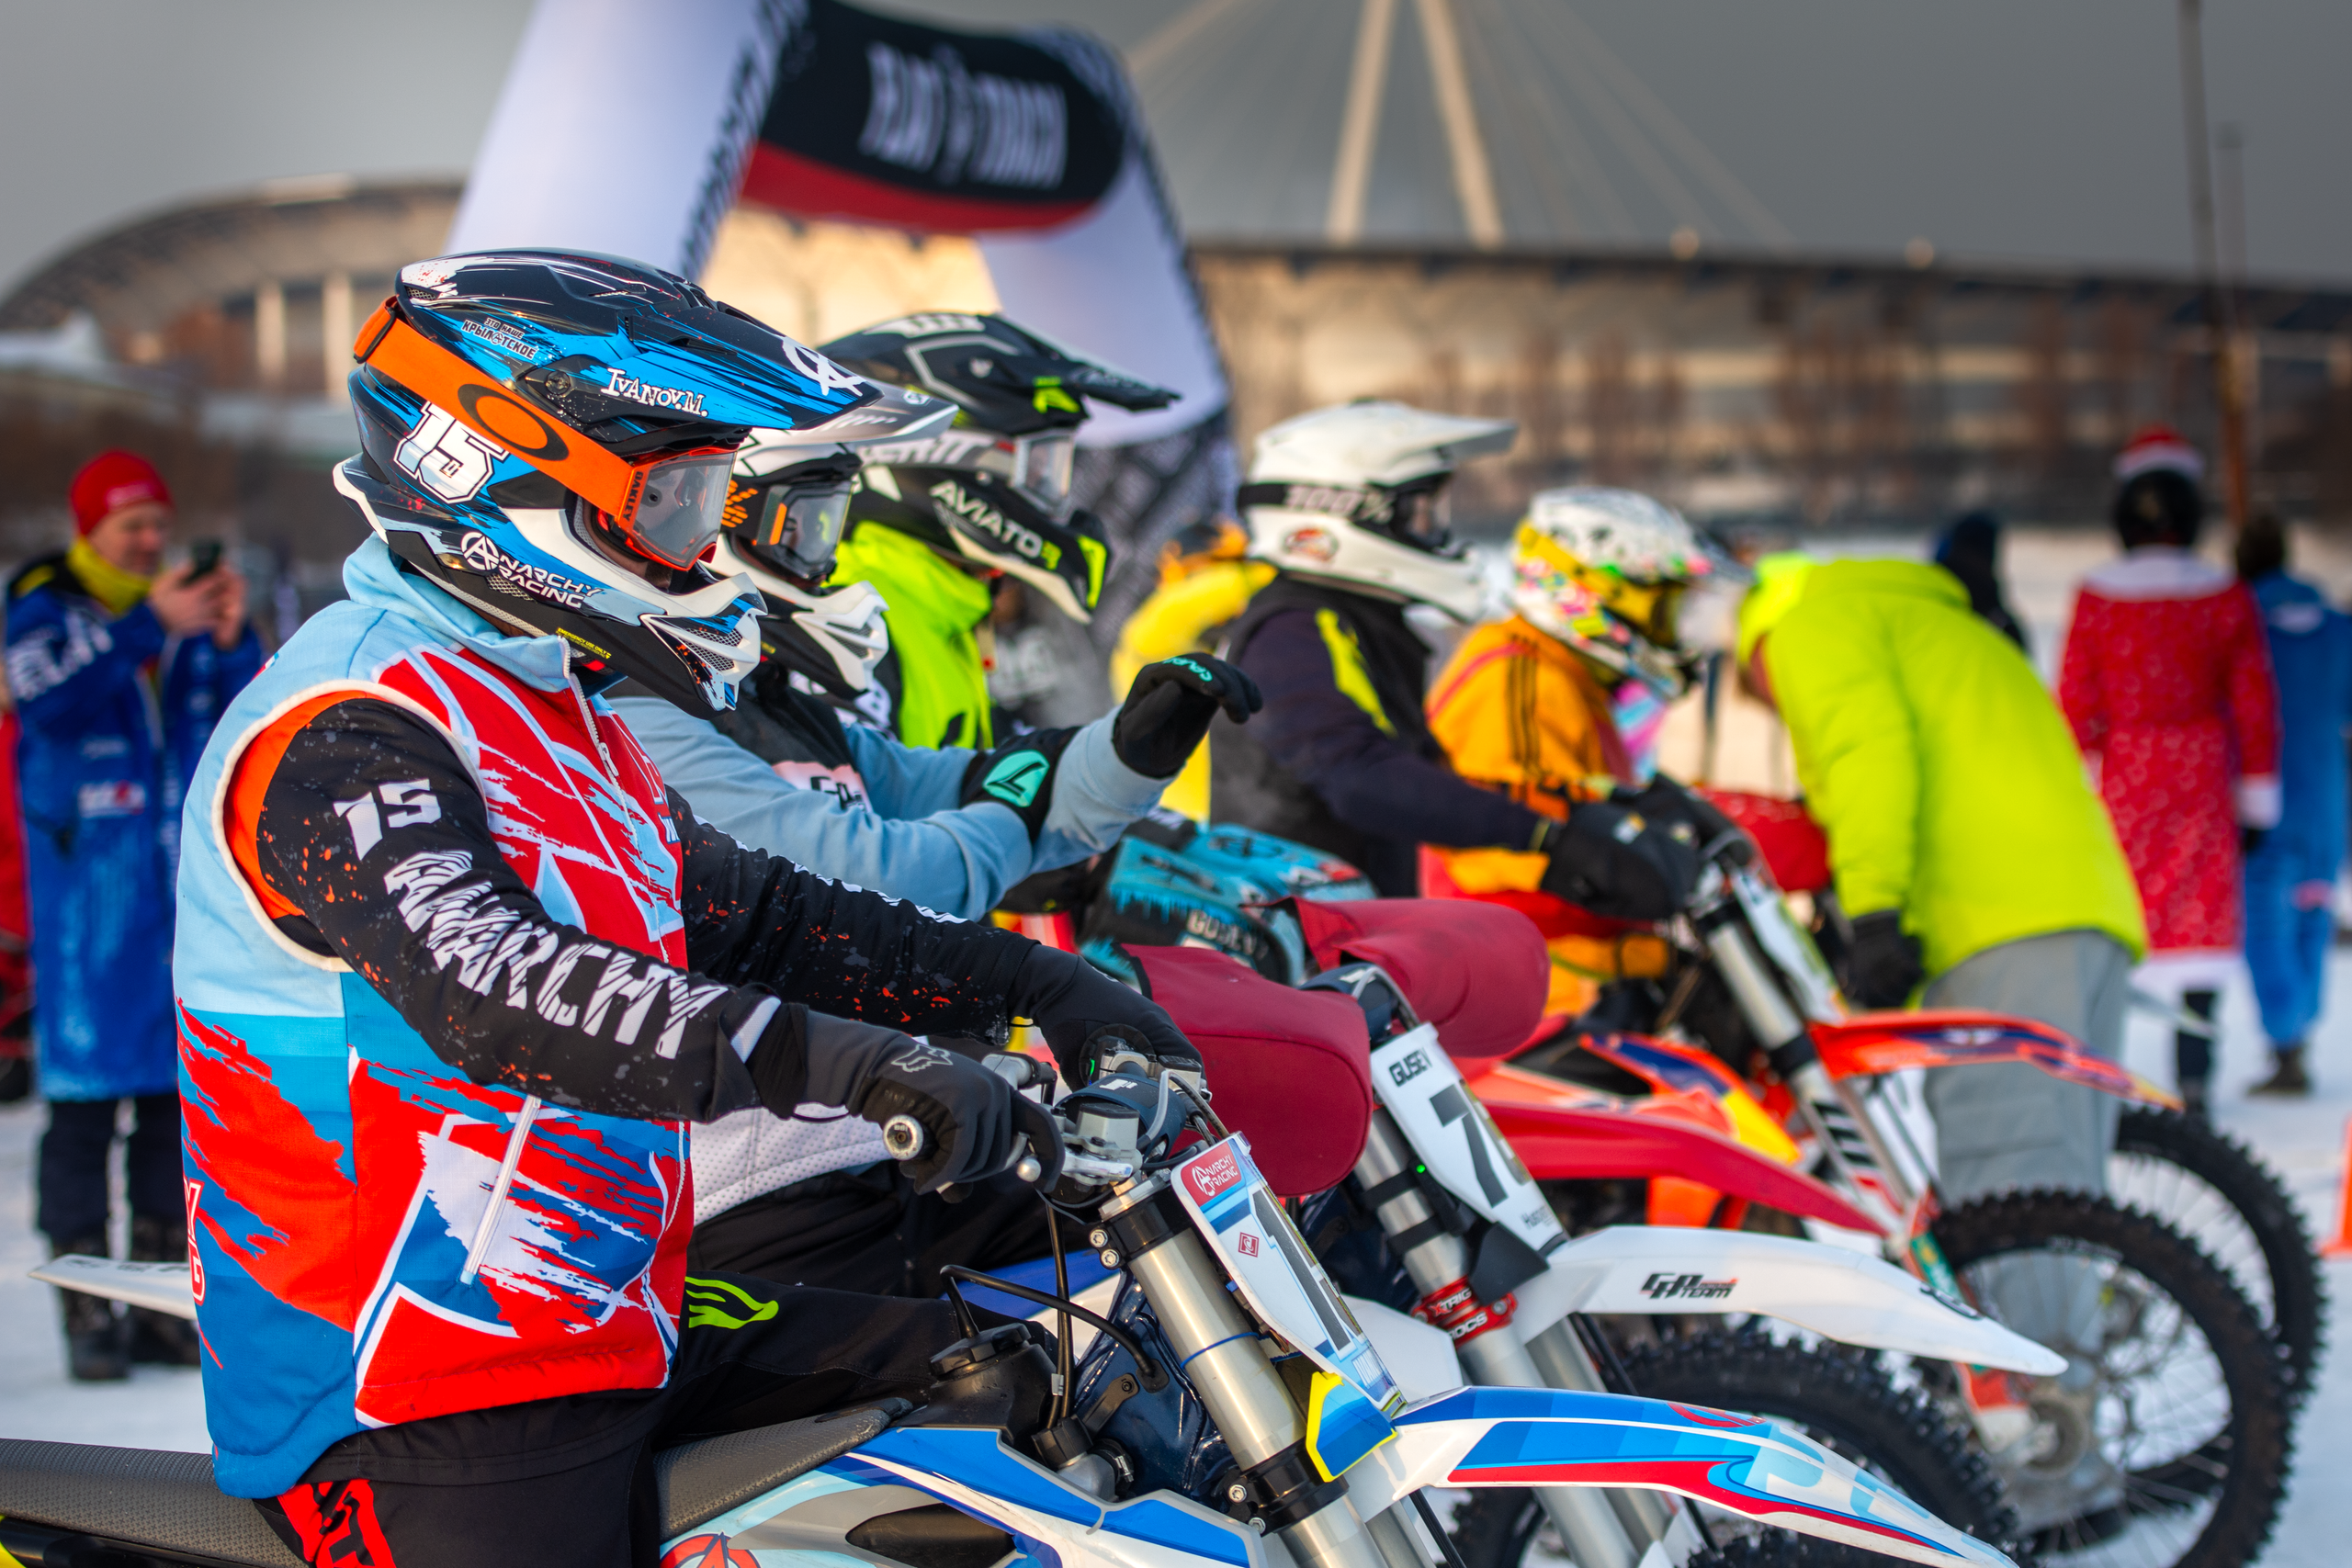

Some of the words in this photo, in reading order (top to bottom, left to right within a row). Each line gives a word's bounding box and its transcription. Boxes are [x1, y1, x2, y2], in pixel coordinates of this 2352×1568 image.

[484, 318, 501, 329] ЭТО
[500, 323, 525, 339] НАШЕ
[393, 400, 511, 504] 15
[623, 471, 643, 522] OAKLEY
[461, 531, 604, 597] ANARCHY
[498, 565, 585, 608] RACING
[334, 779, 442, 861] 15
[383, 851, 729, 1059] ANARCHY
[1212, 1166, 1238, 1186] RACING
[1429, 1287, 1473, 1316] XTRIG
[1679, 1287, 1734, 1298] TEAM
